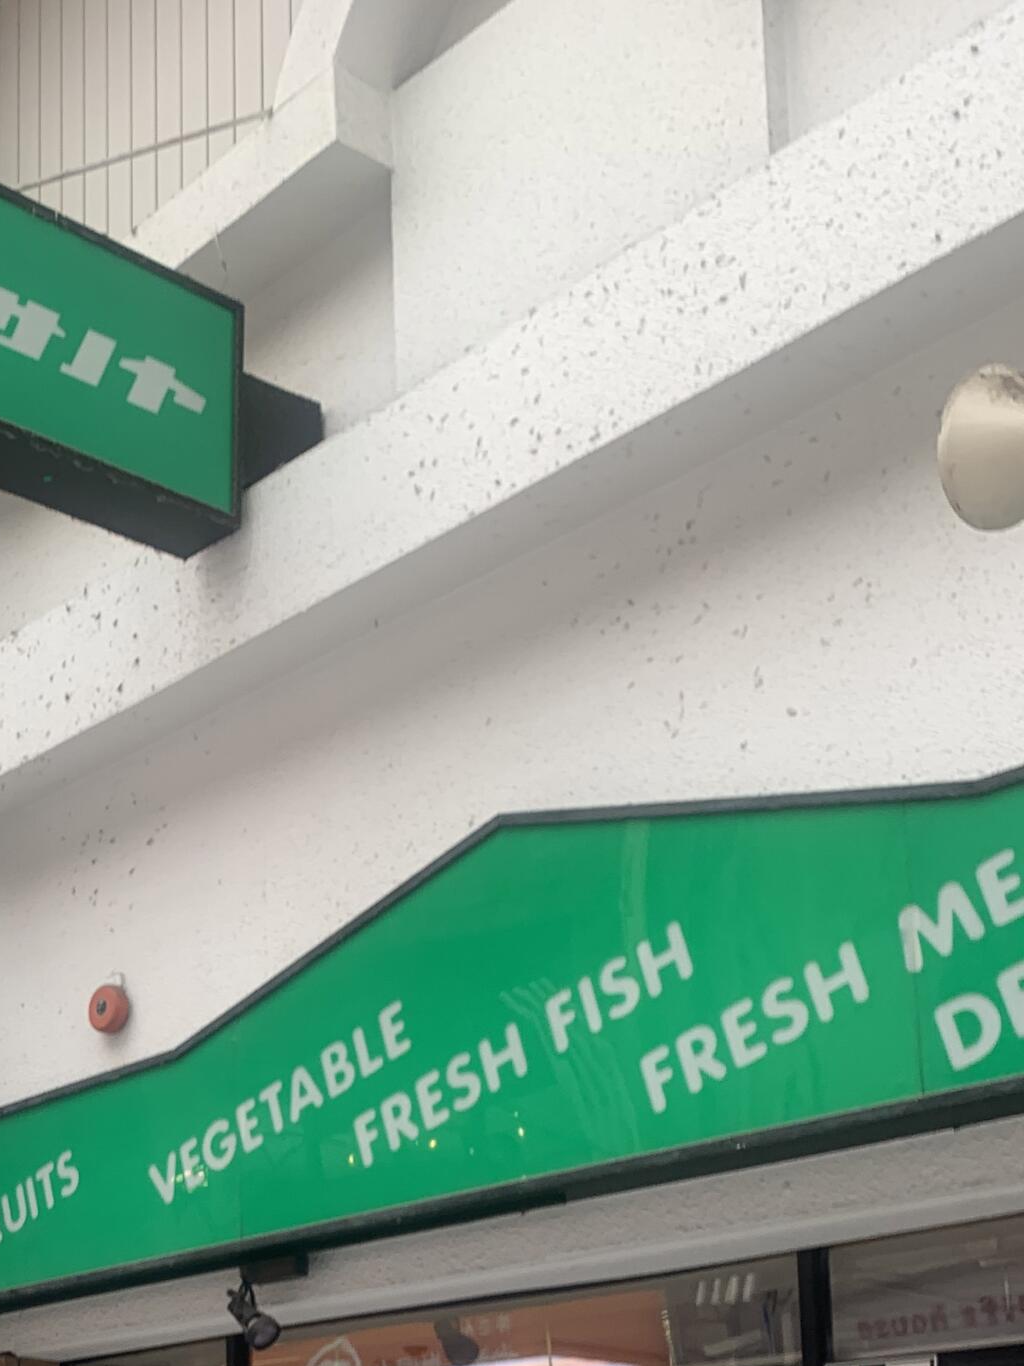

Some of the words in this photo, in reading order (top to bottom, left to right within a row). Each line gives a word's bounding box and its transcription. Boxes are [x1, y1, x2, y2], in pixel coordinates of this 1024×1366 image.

[148, 999, 412, 1205] VEGETABLE
[352, 1022, 529, 1169] FRESH
[545, 921, 695, 1054] FISH
[639, 940, 871, 1114] FRESH
